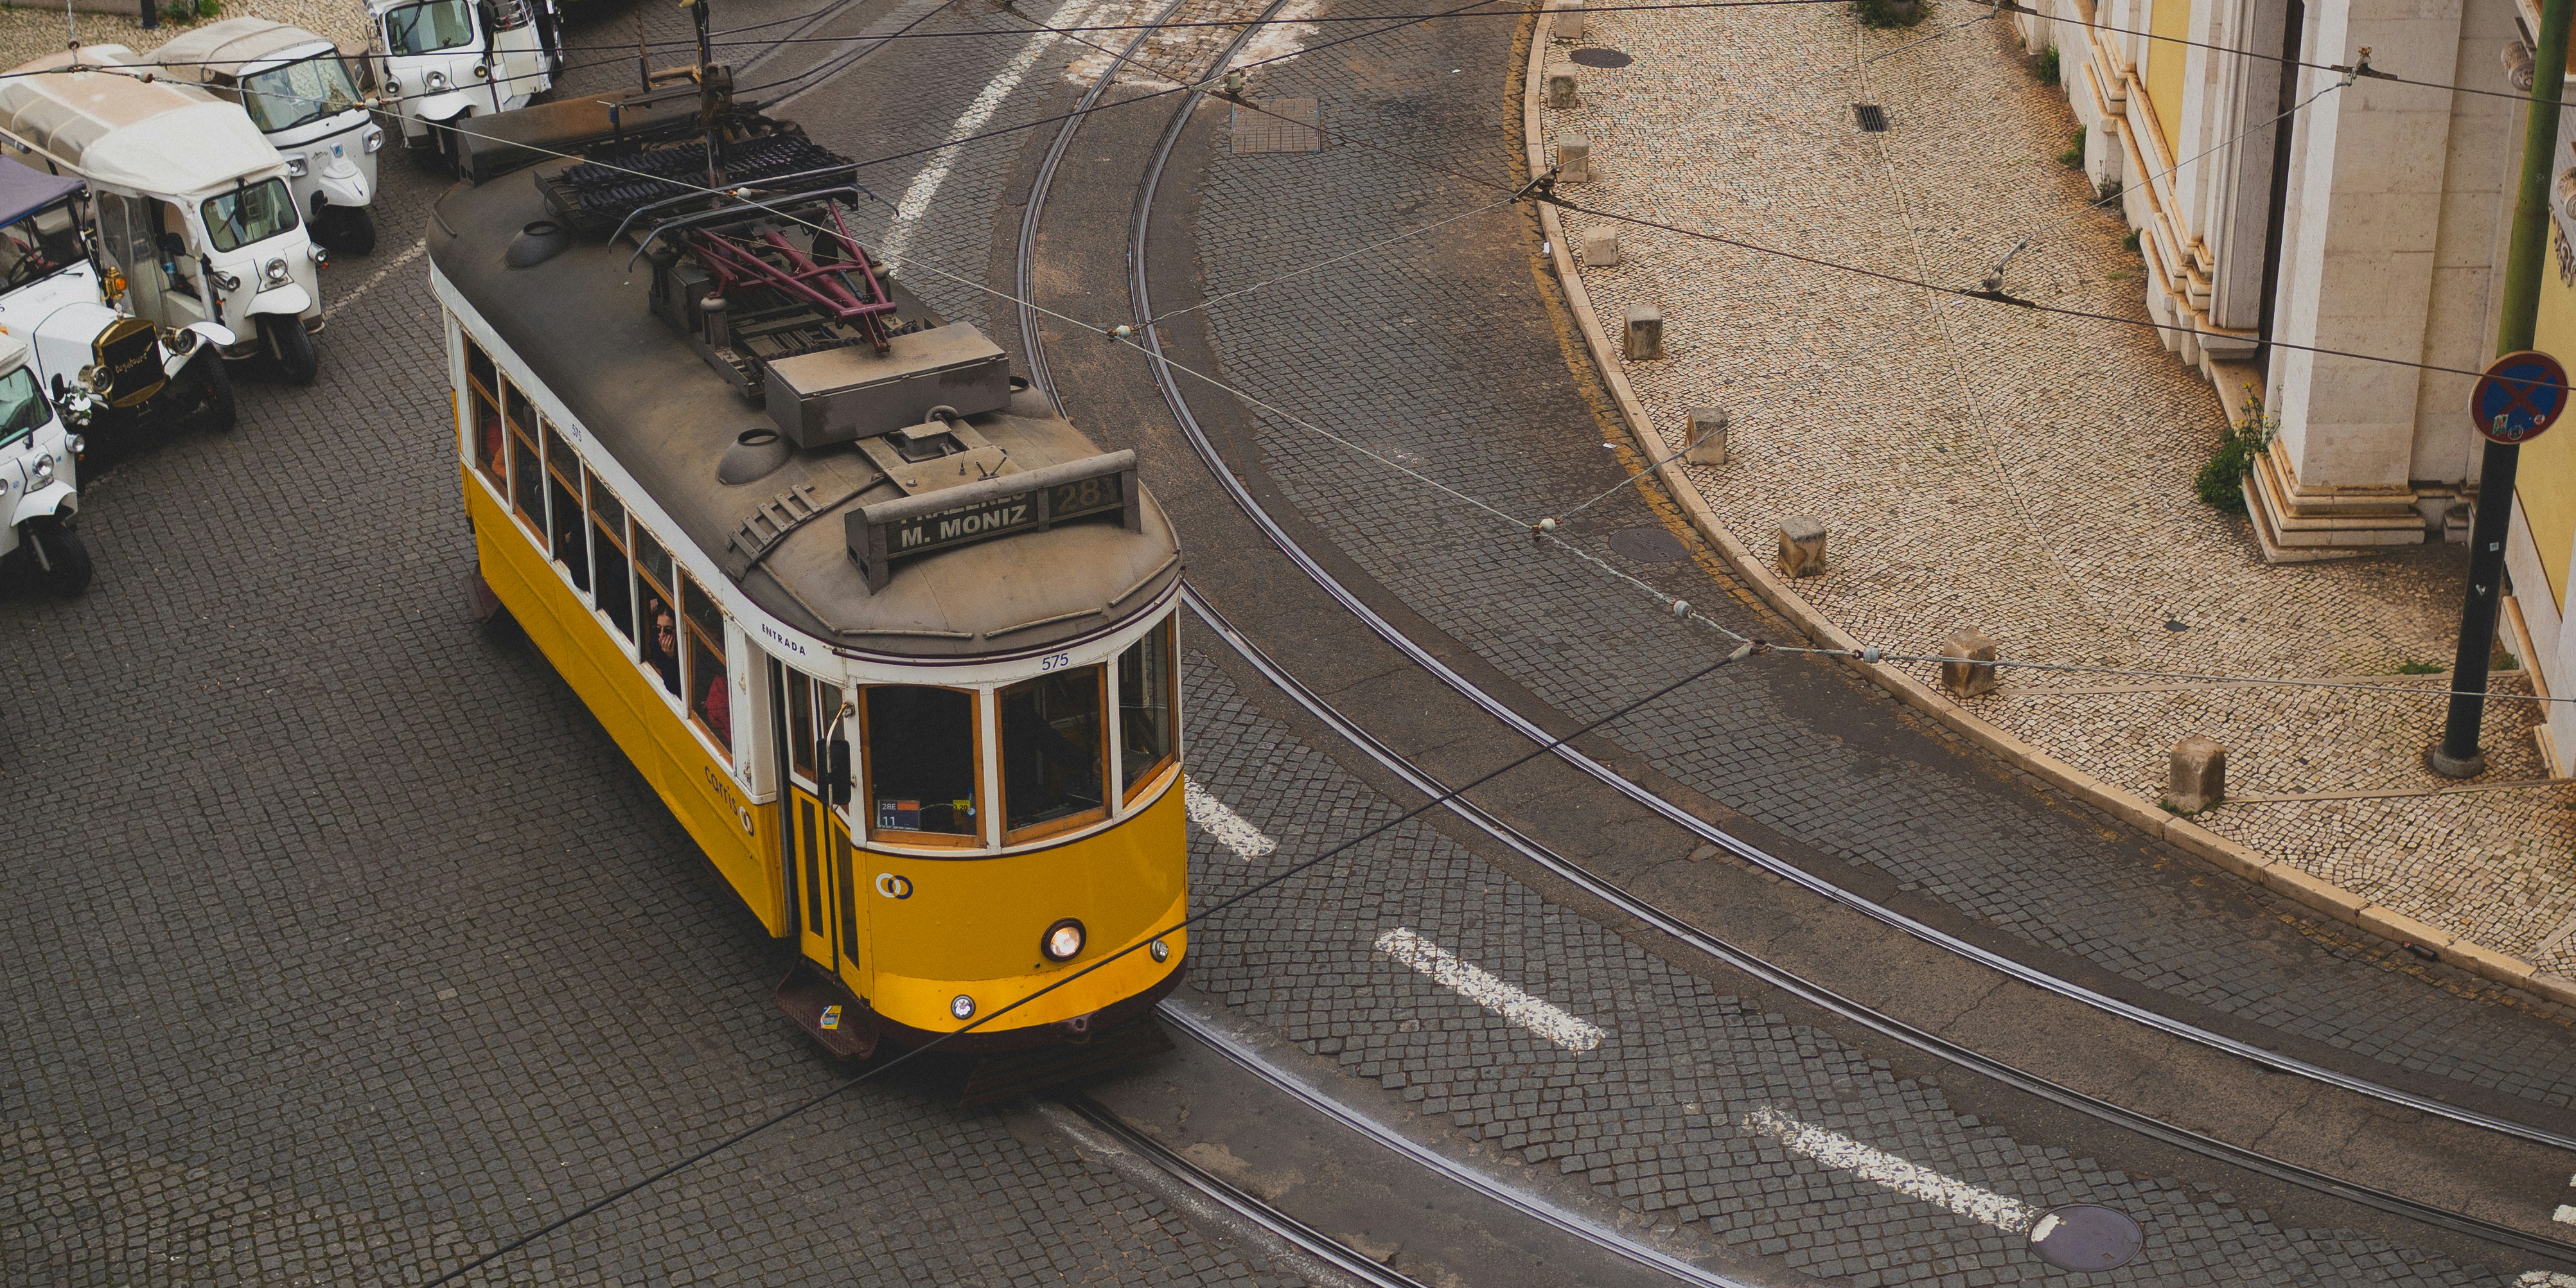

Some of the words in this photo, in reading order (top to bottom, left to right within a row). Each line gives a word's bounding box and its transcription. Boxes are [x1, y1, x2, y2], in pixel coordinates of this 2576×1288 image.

[572, 424, 582, 442] 575
[902, 527, 930, 547] M.
[940, 505, 1027, 539] MONIZ
[762, 623, 806, 655] ENTRADA
[1042, 652, 1069, 671] 575
[705, 766, 737, 816] carris
[883, 816, 895, 825] 11
